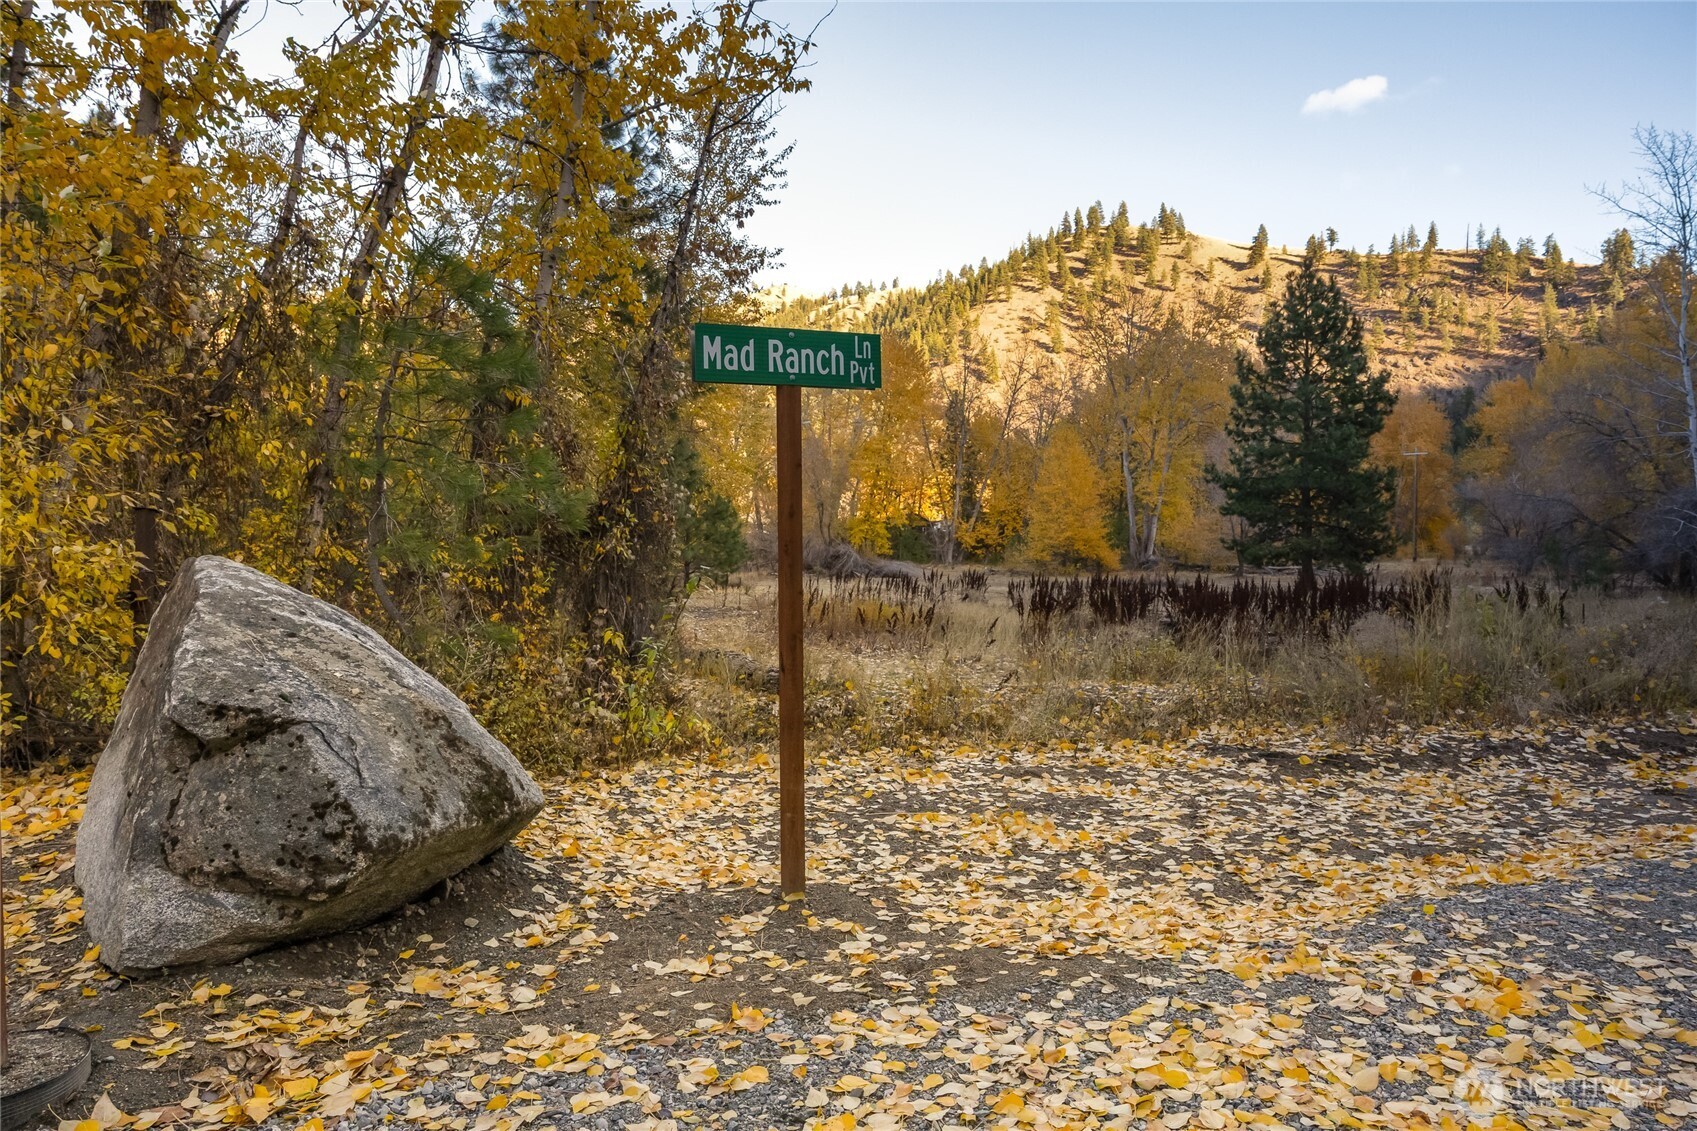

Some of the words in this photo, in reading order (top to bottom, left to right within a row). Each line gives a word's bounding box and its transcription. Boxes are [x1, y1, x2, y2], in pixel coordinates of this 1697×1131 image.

[702, 335, 755, 371] Mad
[768, 339, 845, 376] Ranch
[854, 335, 871, 359] Ln
[850, 361, 875, 385] Pvt
